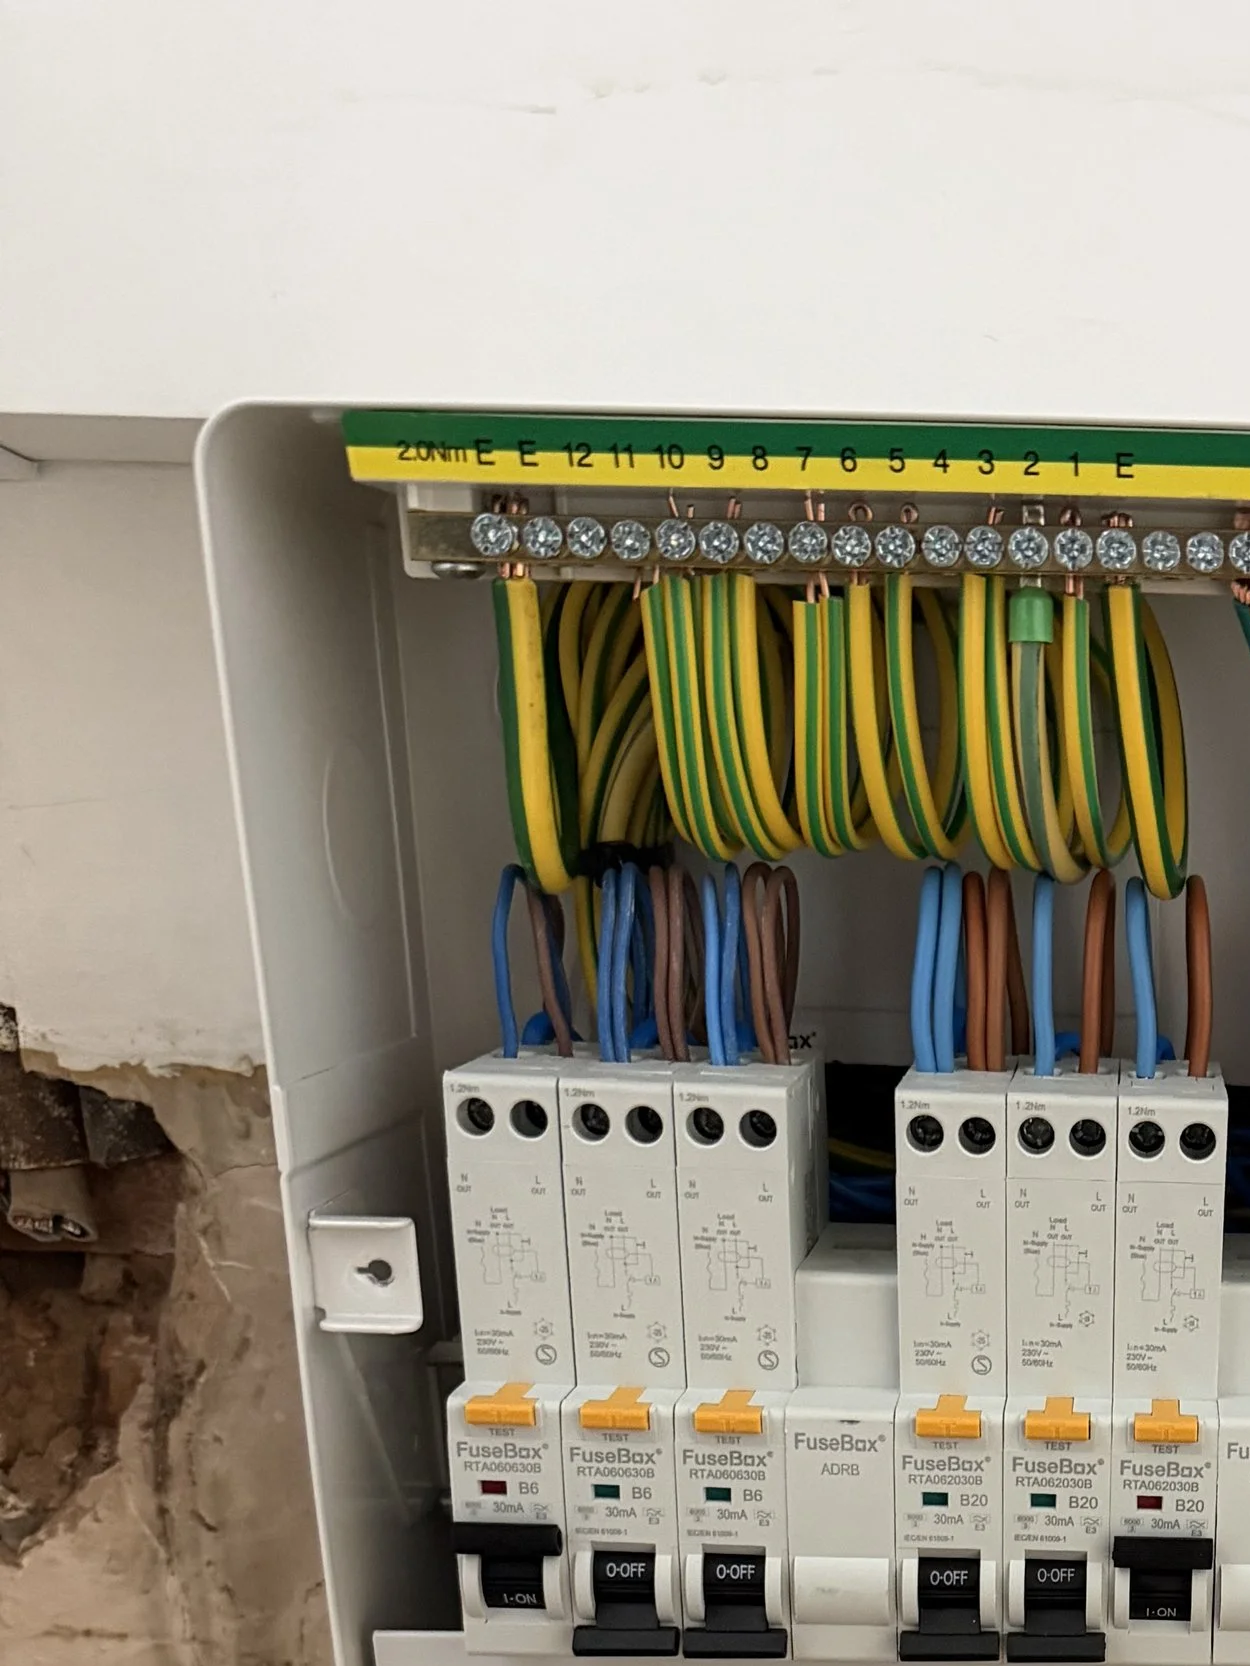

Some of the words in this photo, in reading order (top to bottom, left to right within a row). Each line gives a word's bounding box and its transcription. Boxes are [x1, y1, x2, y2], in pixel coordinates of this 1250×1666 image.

[476, 438, 496, 466] E
[518, 439, 537, 467] E
[563, 441, 593, 468] 12
[609, 442, 636, 469] 11
[653, 443, 685, 470] 10
[706, 443, 725, 471] 9
[751, 444, 770, 472] 8
[796, 445, 813, 472] 7
[839, 446, 858, 473] 6
[888, 447, 906, 474] 5
[932, 448, 951, 475] 4
[977, 448, 995, 476] 3
[1022, 450, 1041, 477] 2
[1069, 451, 1081, 477] 1
[1115, 453, 1135, 479] E
[489, 1428, 516, 1437] TEST
[602, 1433, 629, 1442] TEST
[715, 1435, 741, 1445] TEST
[932, 1441, 960, 1450] TEST
[1044, 1442, 1071, 1451] TEST
[1152, 1445, 1180, 1454] TEST
[464, 1460, 542, 1473] RTA060630B
[577, 1466, 655, 1479] RTA060630B
[821, 1463, 860, 1476] ADRB
[689, 1469, 766, 1481] RTA060630B
[908, 1474, 983, 1486] RTA062030B
[518, 1481, 539, 1496] B6
[1015, 1476, 1093, 1489] RTA062030B
[1122, 1479, 1200, 1492] RTA062030B
[631, 1486, 652, 1500] B6
[743, 1489, 763, 1502] B6
[959, 1493, 989, 1508] B20
[1068, 1495, 1099, 1510] B20
[1175, 1499, 1205, 1514] B20
[492, 1501, 525, 1514] 30mA
[604, 1506, 637, 1519] 30mA
[716, 1508, 749, 1521] 30mA
[933, 1513, 964, 1526] 30mA
[1044, 1515, 1074, 1527] 30mA
[1150, 1518, 1181, 1530] 30mA
